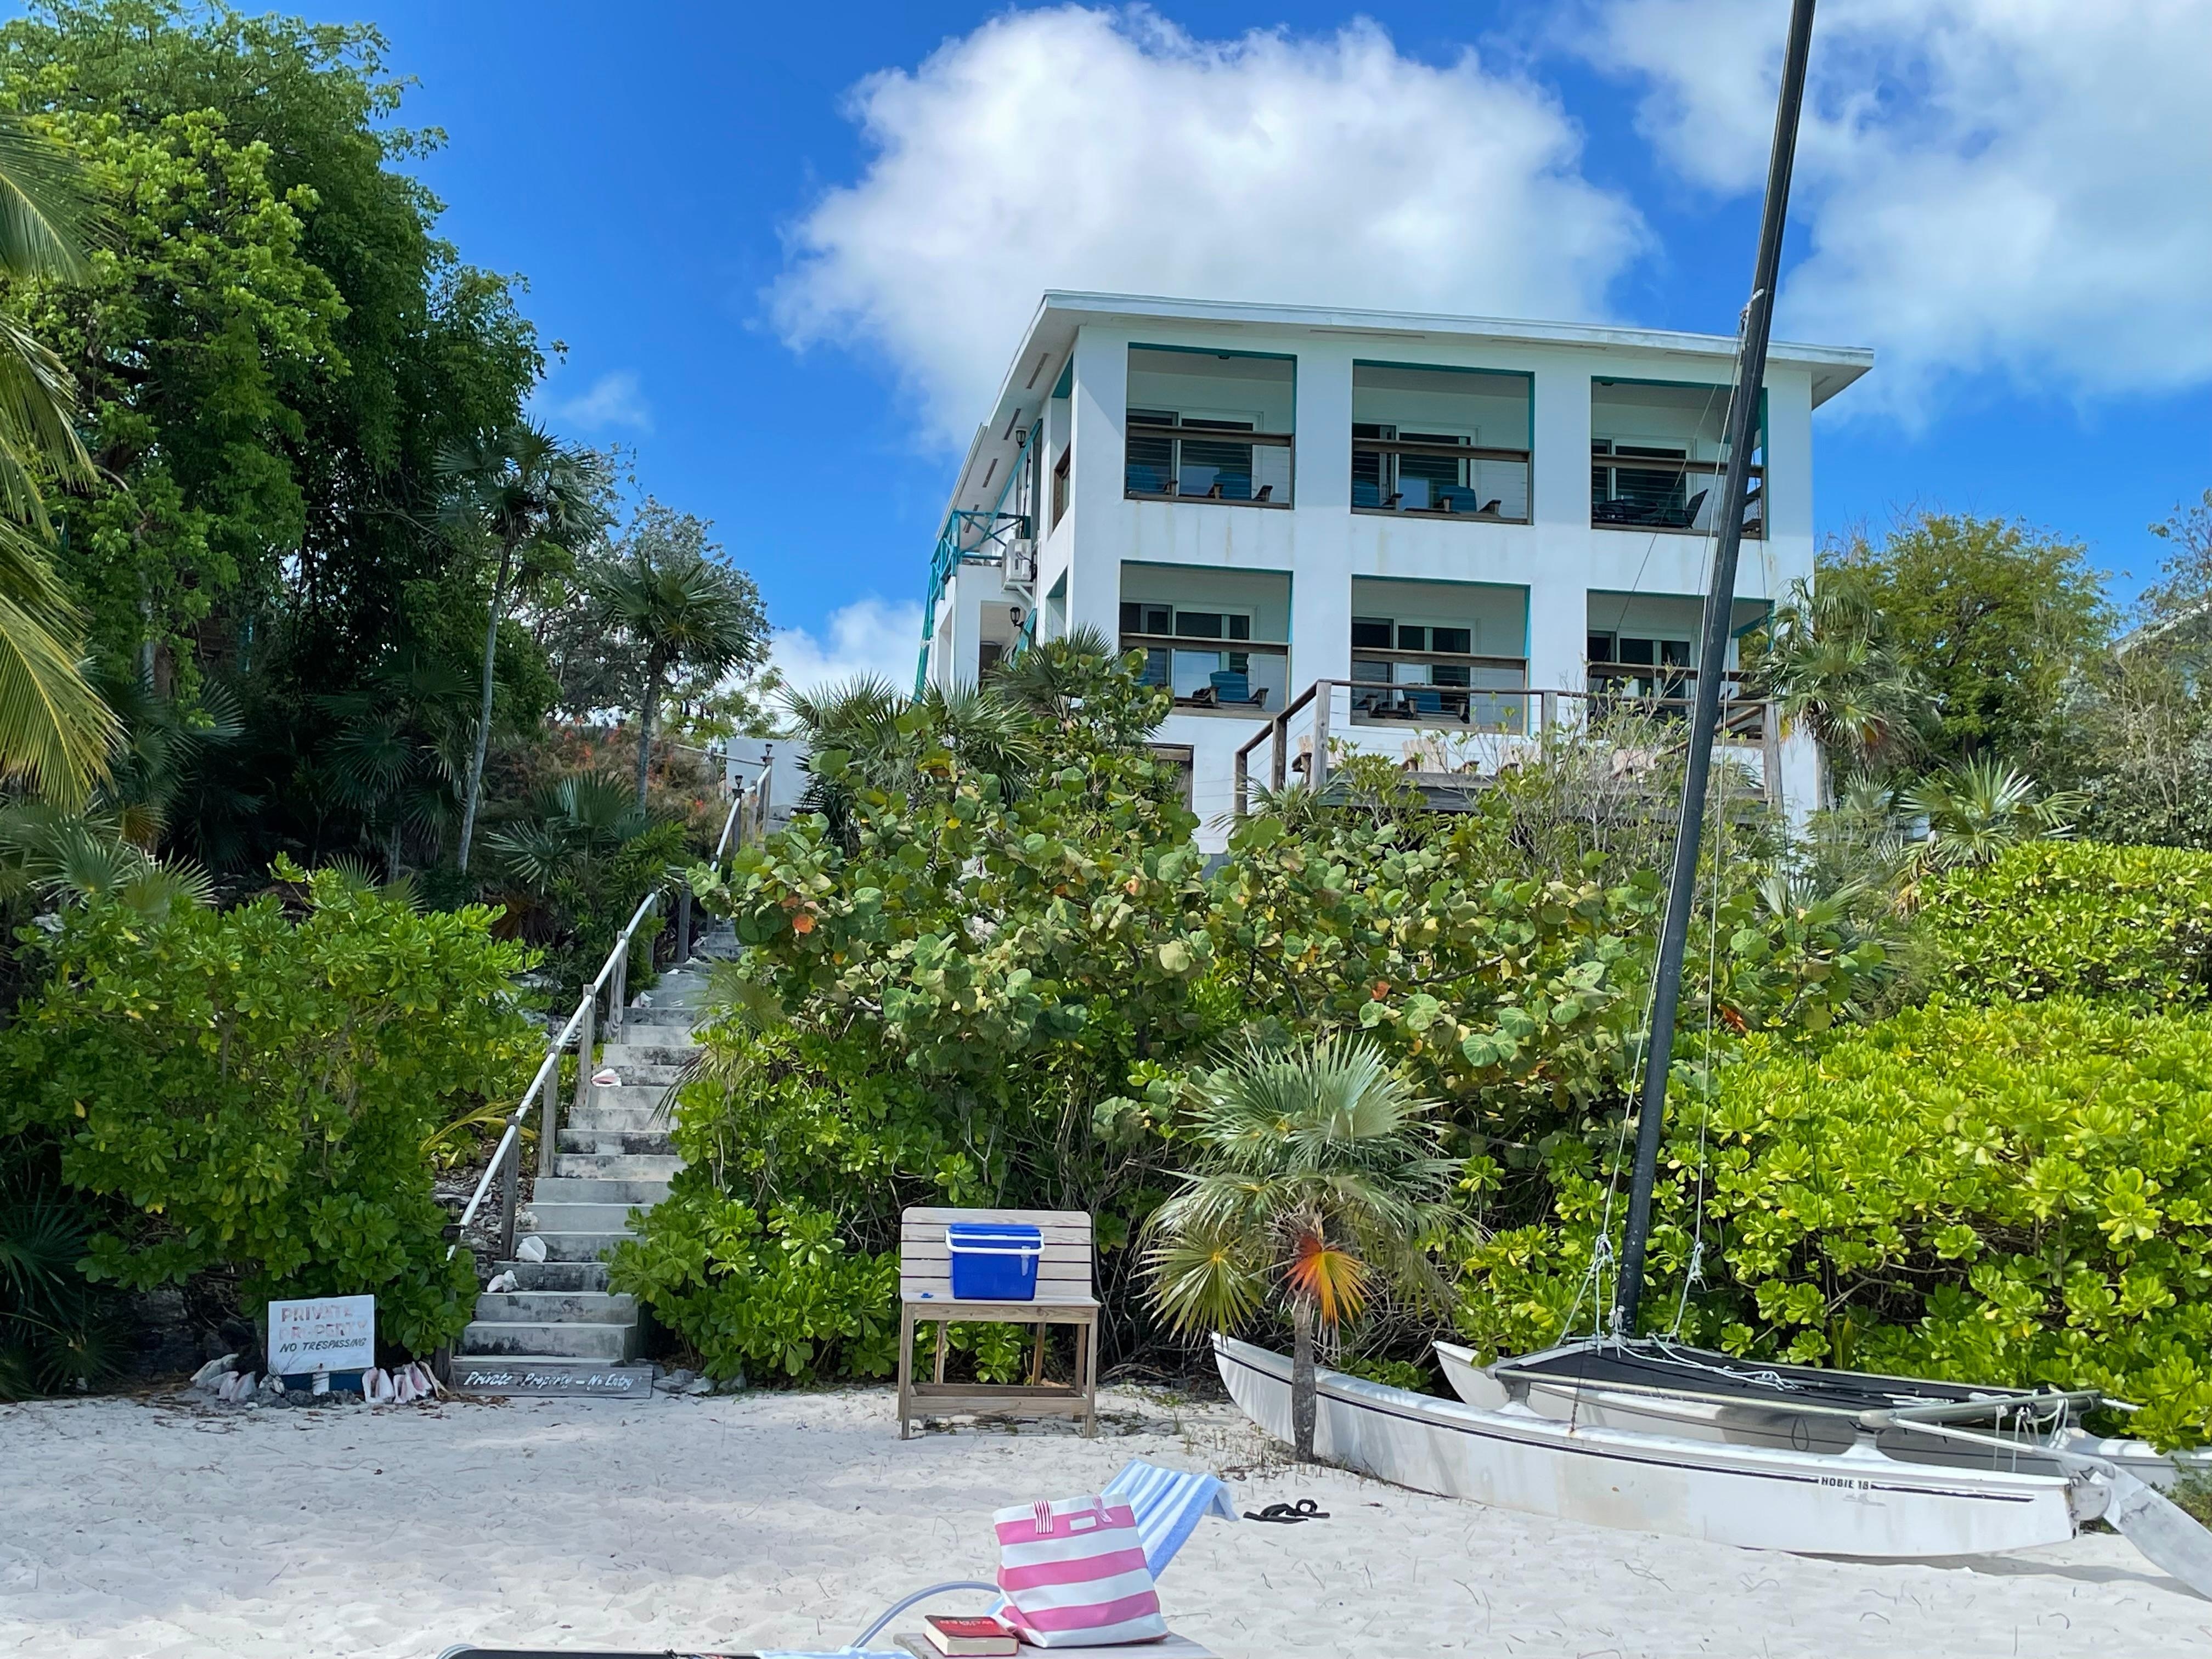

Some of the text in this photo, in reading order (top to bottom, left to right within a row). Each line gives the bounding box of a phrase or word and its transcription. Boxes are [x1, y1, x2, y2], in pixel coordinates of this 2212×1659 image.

[281, 1304, 353, 1323] PRIVATE
[279, 1338, 367, 1353] NO TRESPASSING
[464, 1371, 512, 1386] Private
[521, 1373, 573, 1389] Property
[588, 1374, 602, 1387] No
[1821, 1477, 1870, 1490] HOBIE 18
